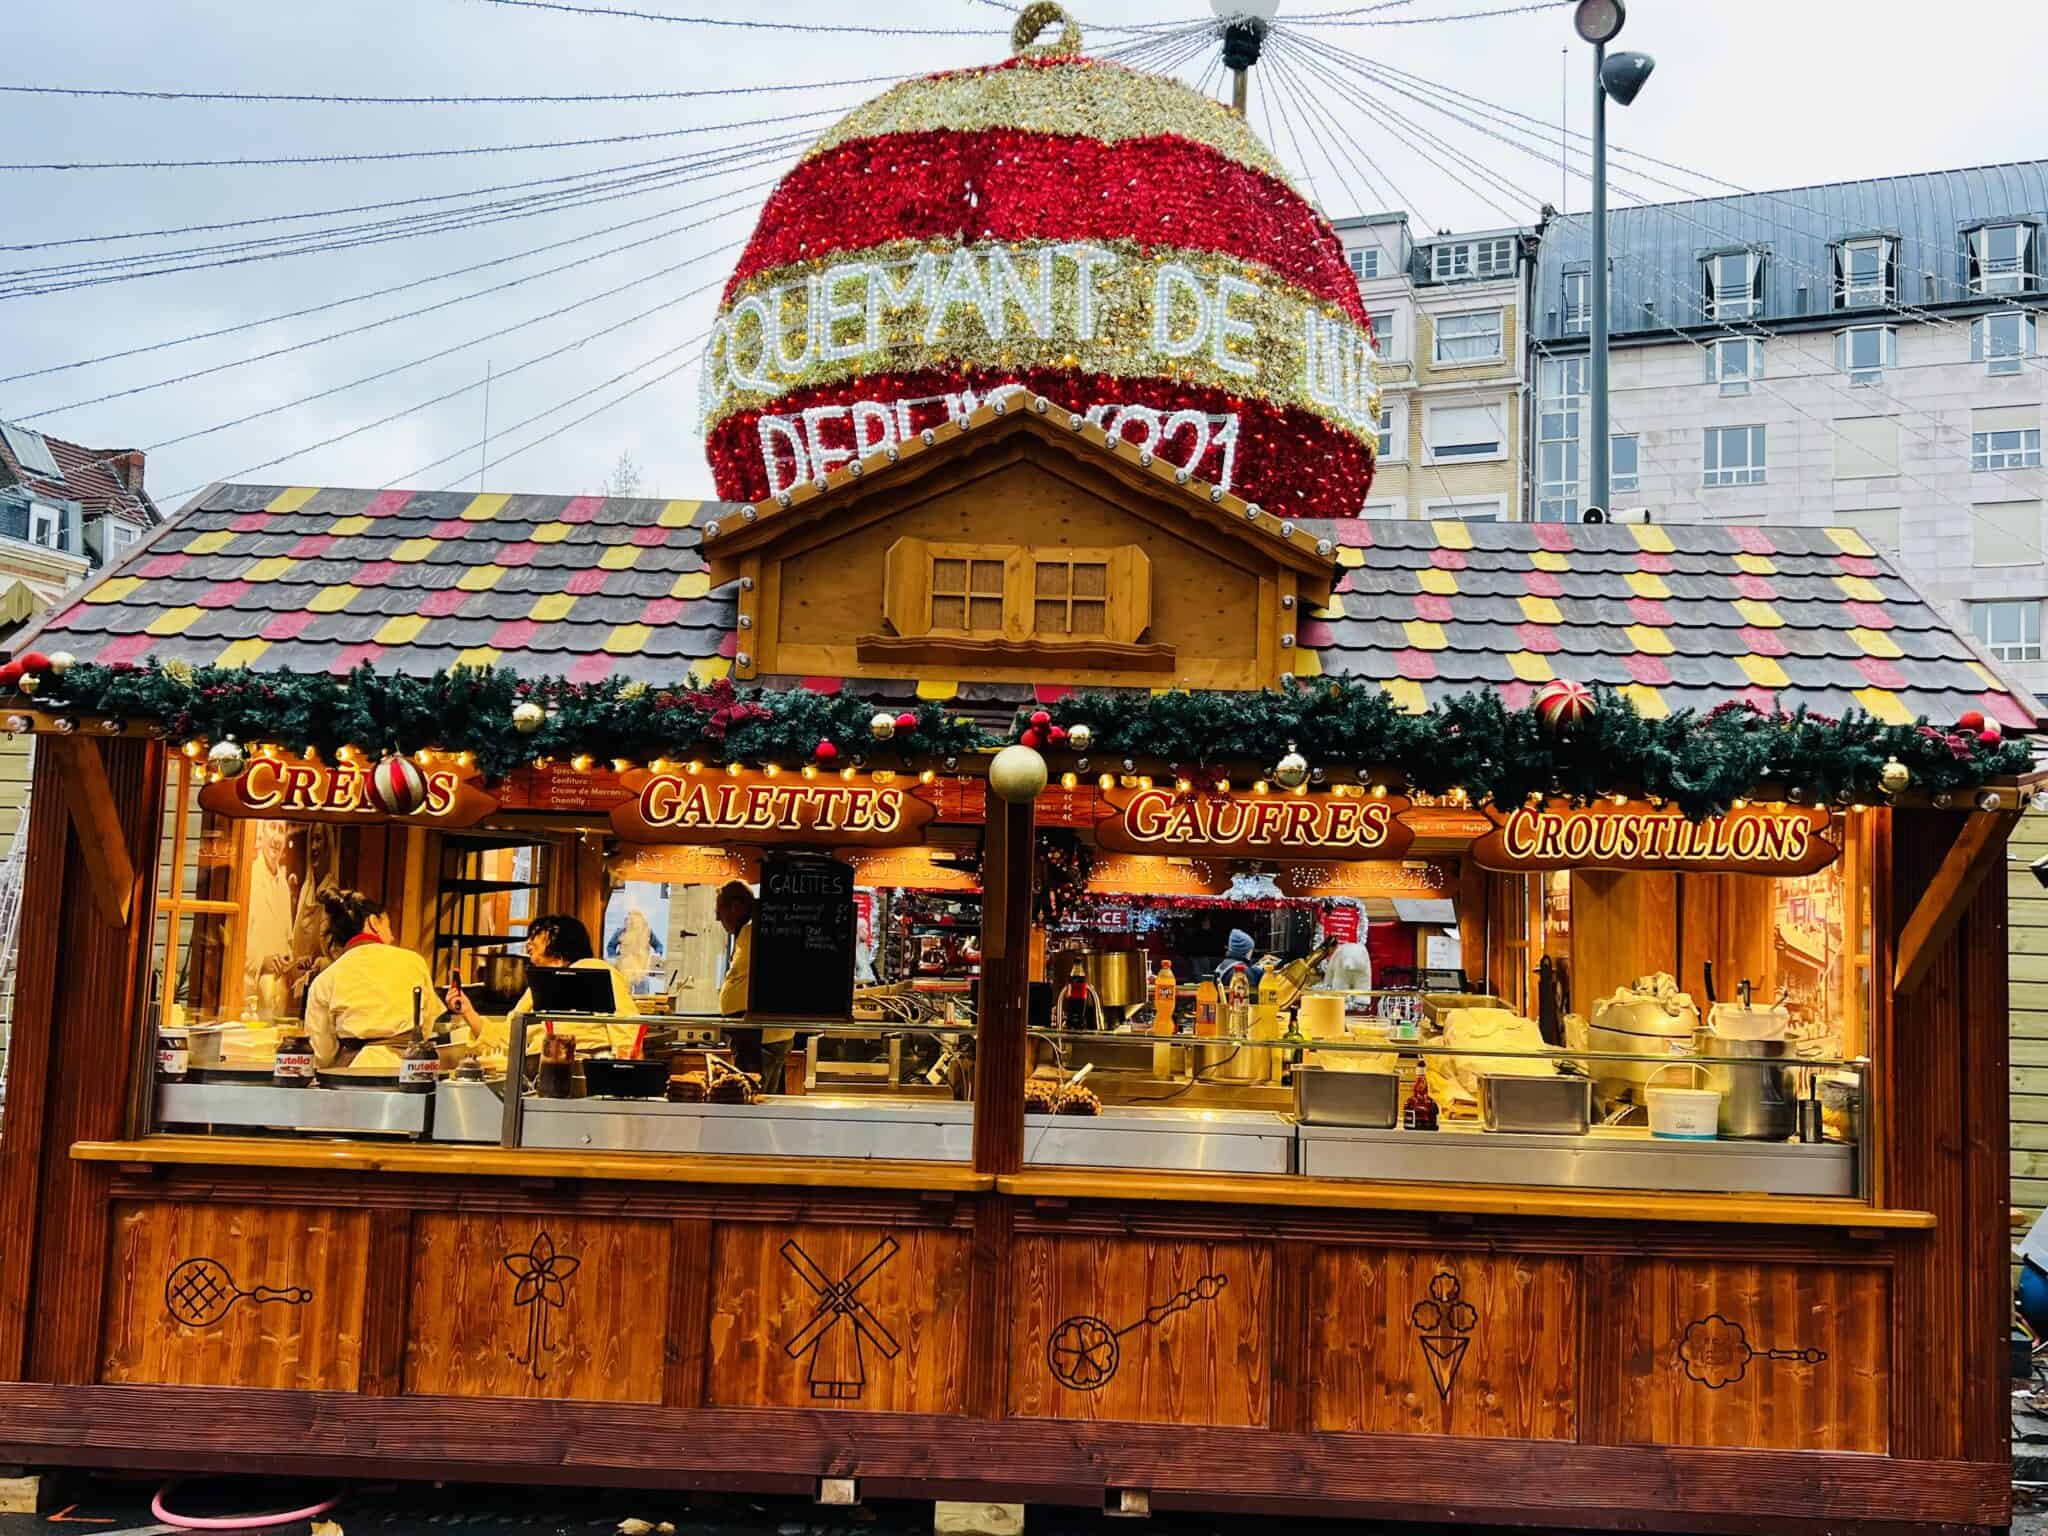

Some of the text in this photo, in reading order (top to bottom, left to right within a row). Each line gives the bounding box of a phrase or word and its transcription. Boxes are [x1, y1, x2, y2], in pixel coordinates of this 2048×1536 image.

[1154, 261, 1262, 376] DE
[1085, 403, 1240, 491] 921
[639, 774, 903, 832] GALETTES
[1125, 789, 1392, 847] GAUFRES
[1503, 806, 1812, 861] CROUSTILLONS
